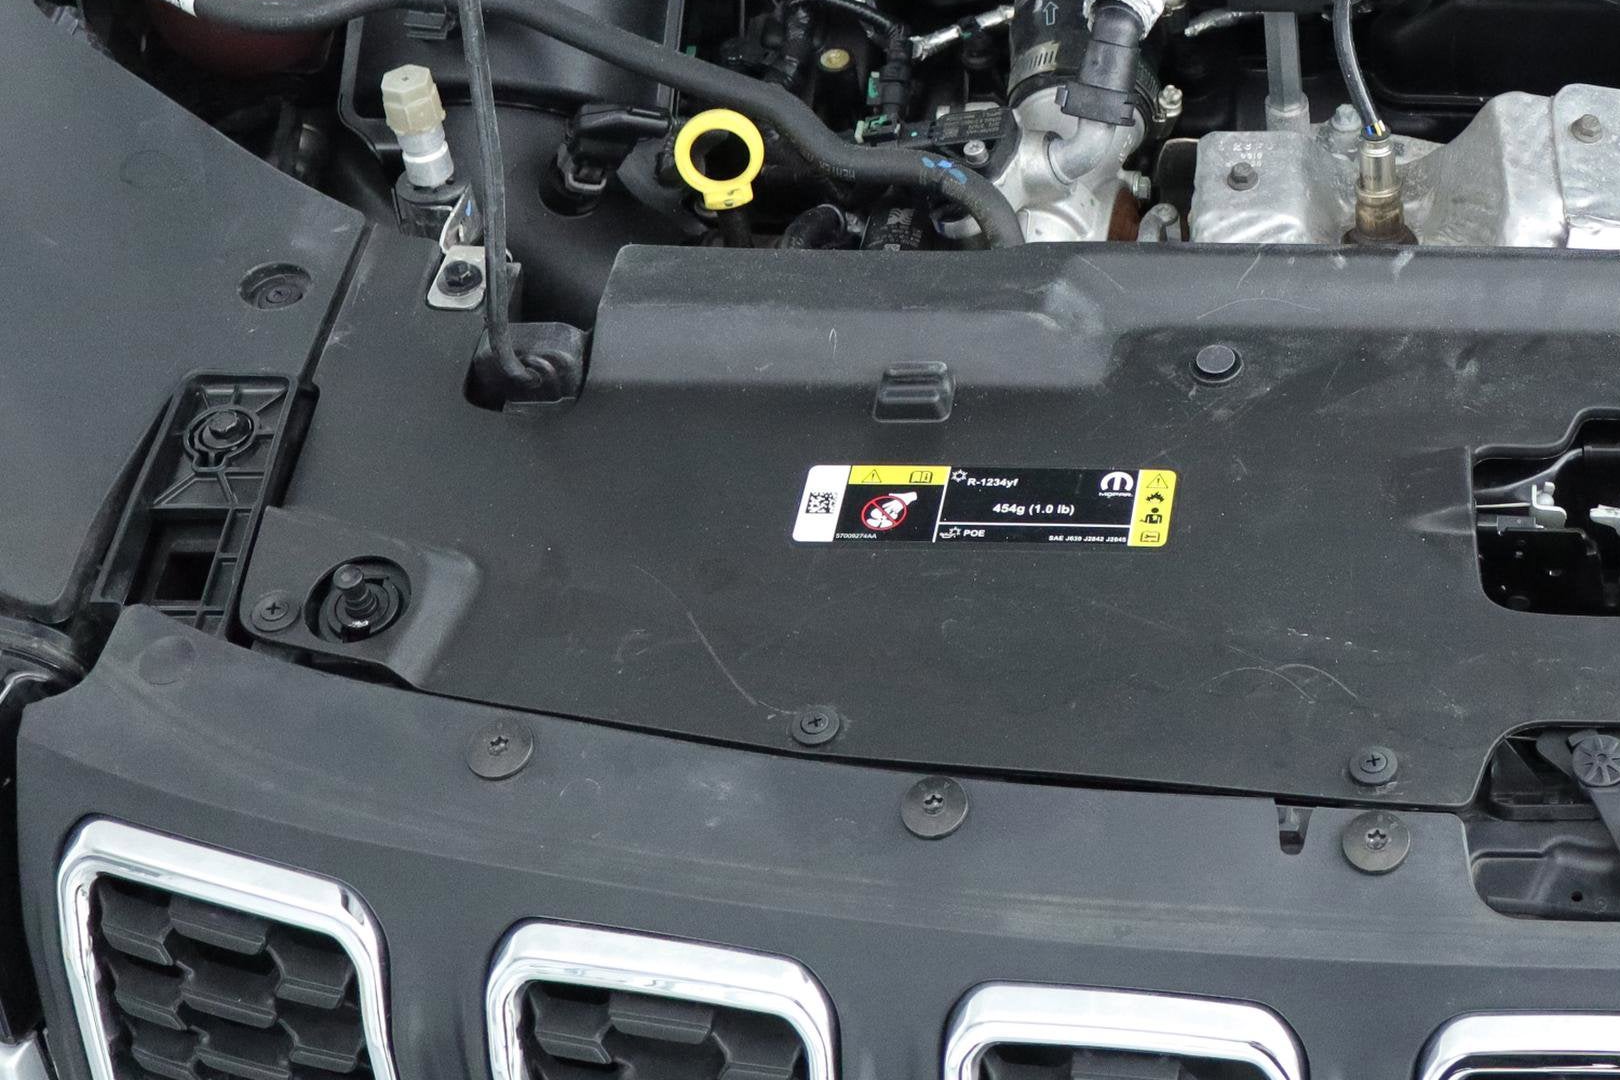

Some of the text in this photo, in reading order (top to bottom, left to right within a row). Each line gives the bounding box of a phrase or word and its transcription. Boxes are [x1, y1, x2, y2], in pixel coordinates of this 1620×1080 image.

[967, 478, 1019, 488] R-1234yf
[992, 503, 1075, 516] 454g (1.0 lb)
[963, 529, 986, 538] POE
